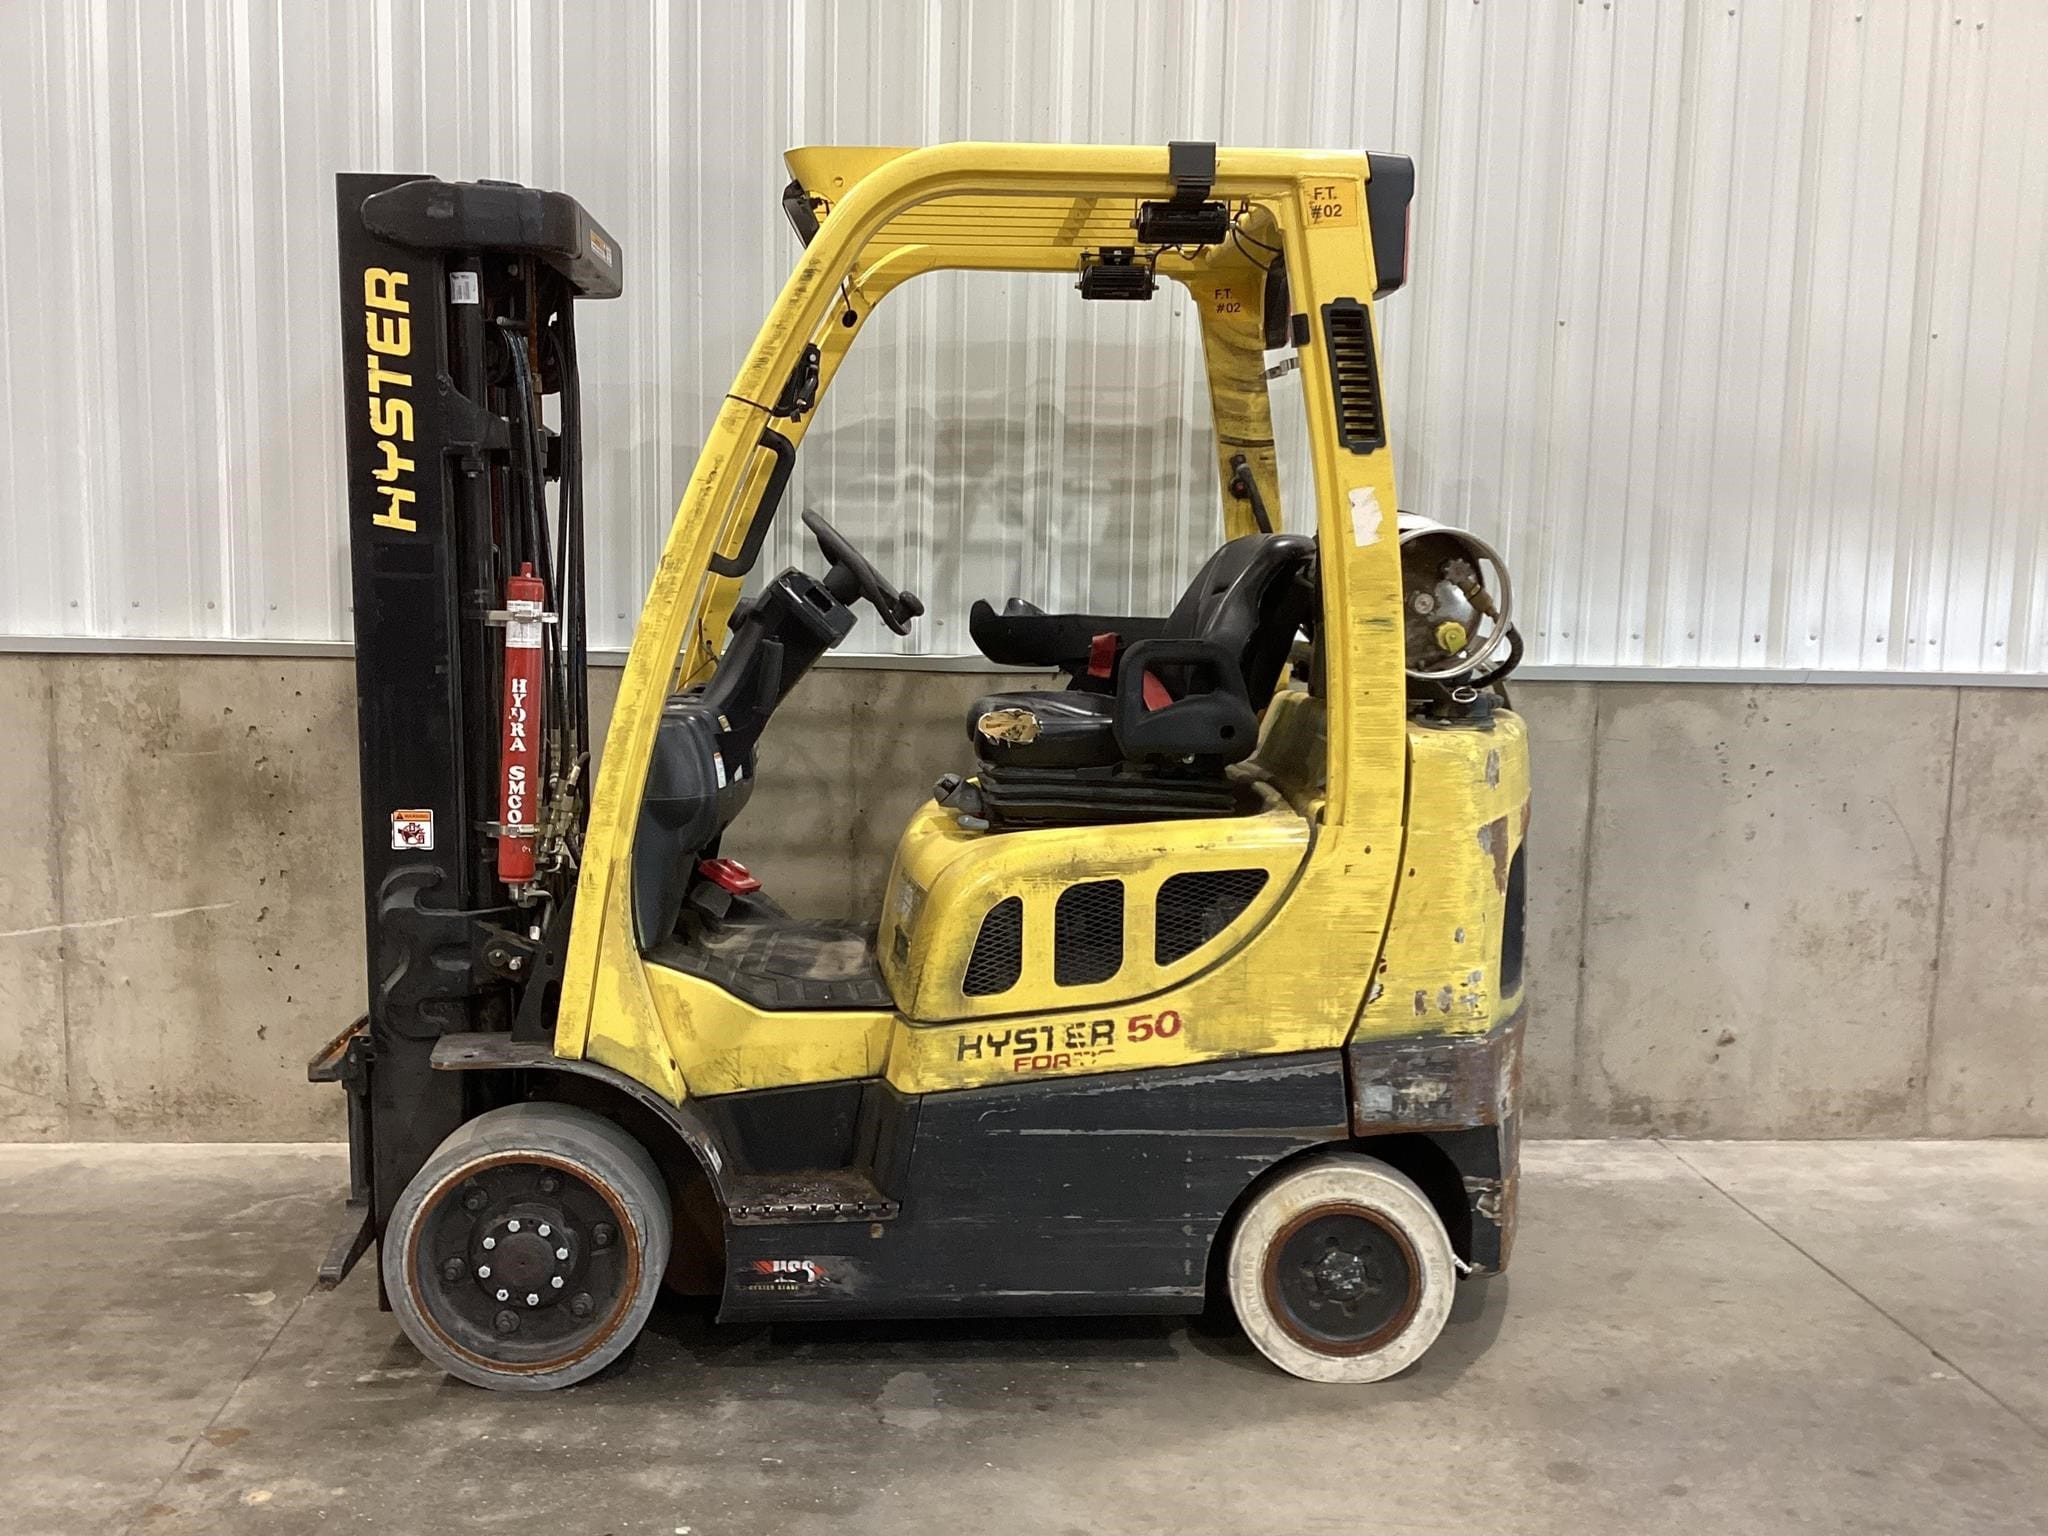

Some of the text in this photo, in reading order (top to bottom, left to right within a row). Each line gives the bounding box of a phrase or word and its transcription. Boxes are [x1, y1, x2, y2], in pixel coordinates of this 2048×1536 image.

[1314, 186, 1337, 200] F.T.
[1311, 204, 1342, 218] #02
[1215, 288, 1233, 300] F.T.
[1216, 302, 1241, 314] #02
[364, 267, 417, 533] HYSTER
[508, 678, 528, 752] HYDRA
[957, 1010, 1182, 1062] HYSTER 50
